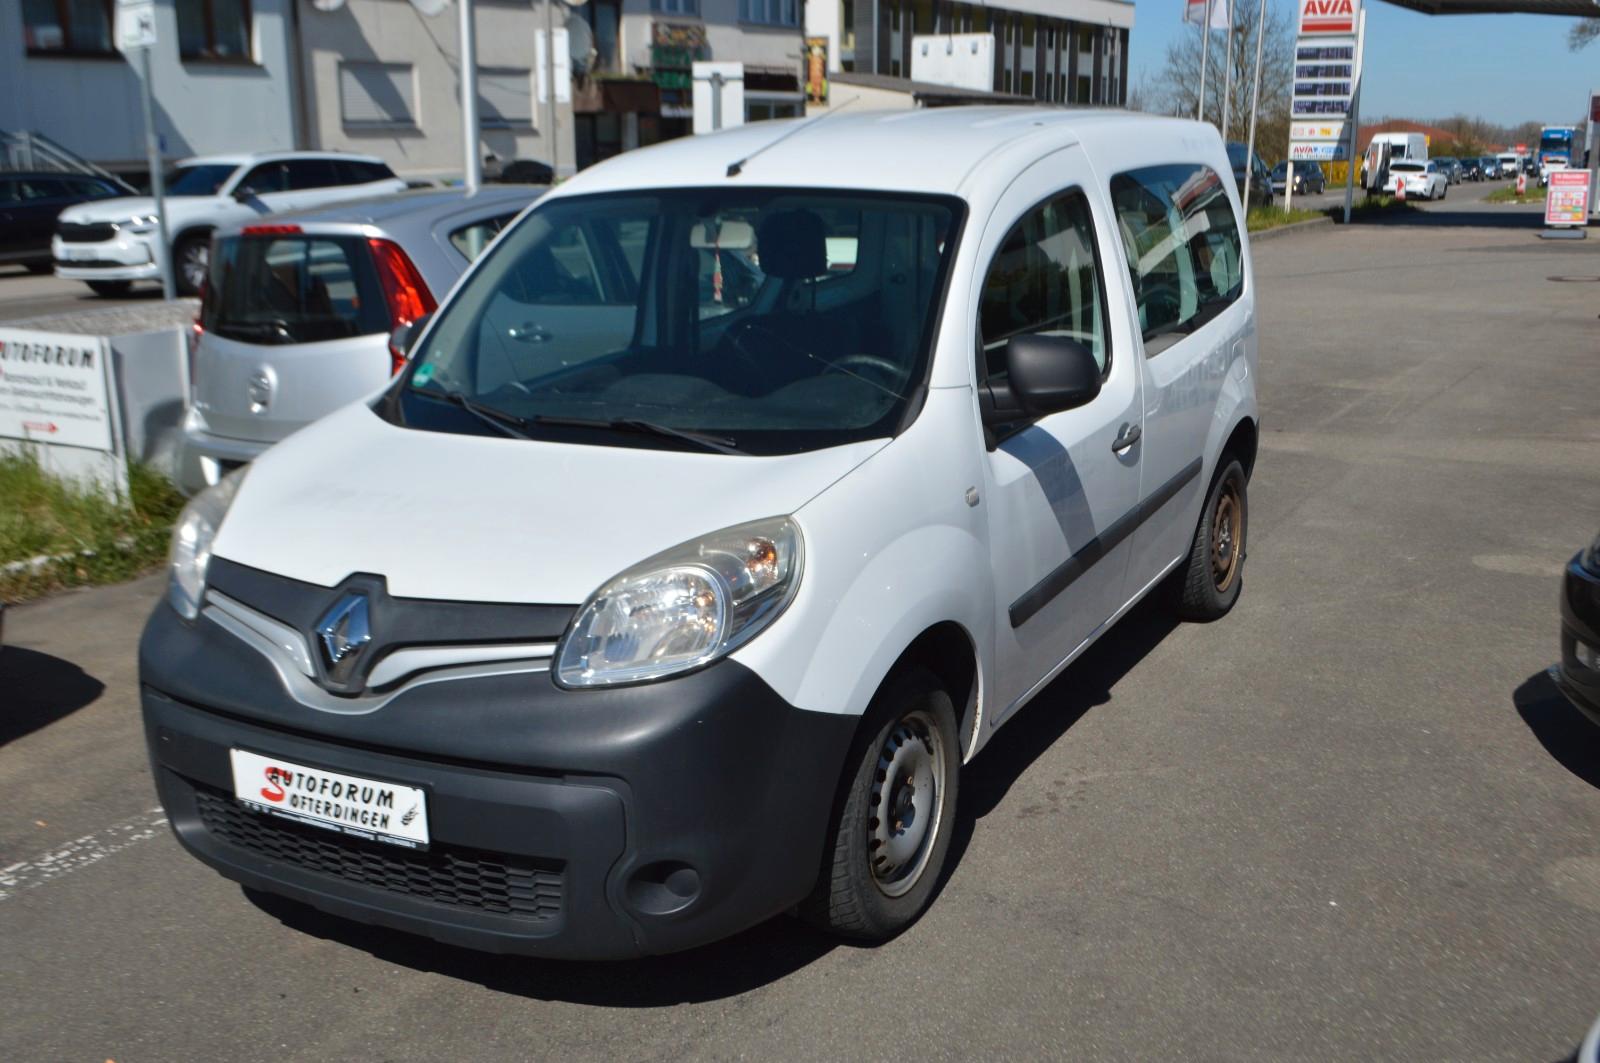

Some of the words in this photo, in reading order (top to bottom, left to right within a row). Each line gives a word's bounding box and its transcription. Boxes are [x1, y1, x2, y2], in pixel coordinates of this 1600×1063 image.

[1303, 0, 1353, 15] AVIA
[0, 341, 95, 369] UTOFORUM
[289, 793, 391, 829] OFTERDINGEN
